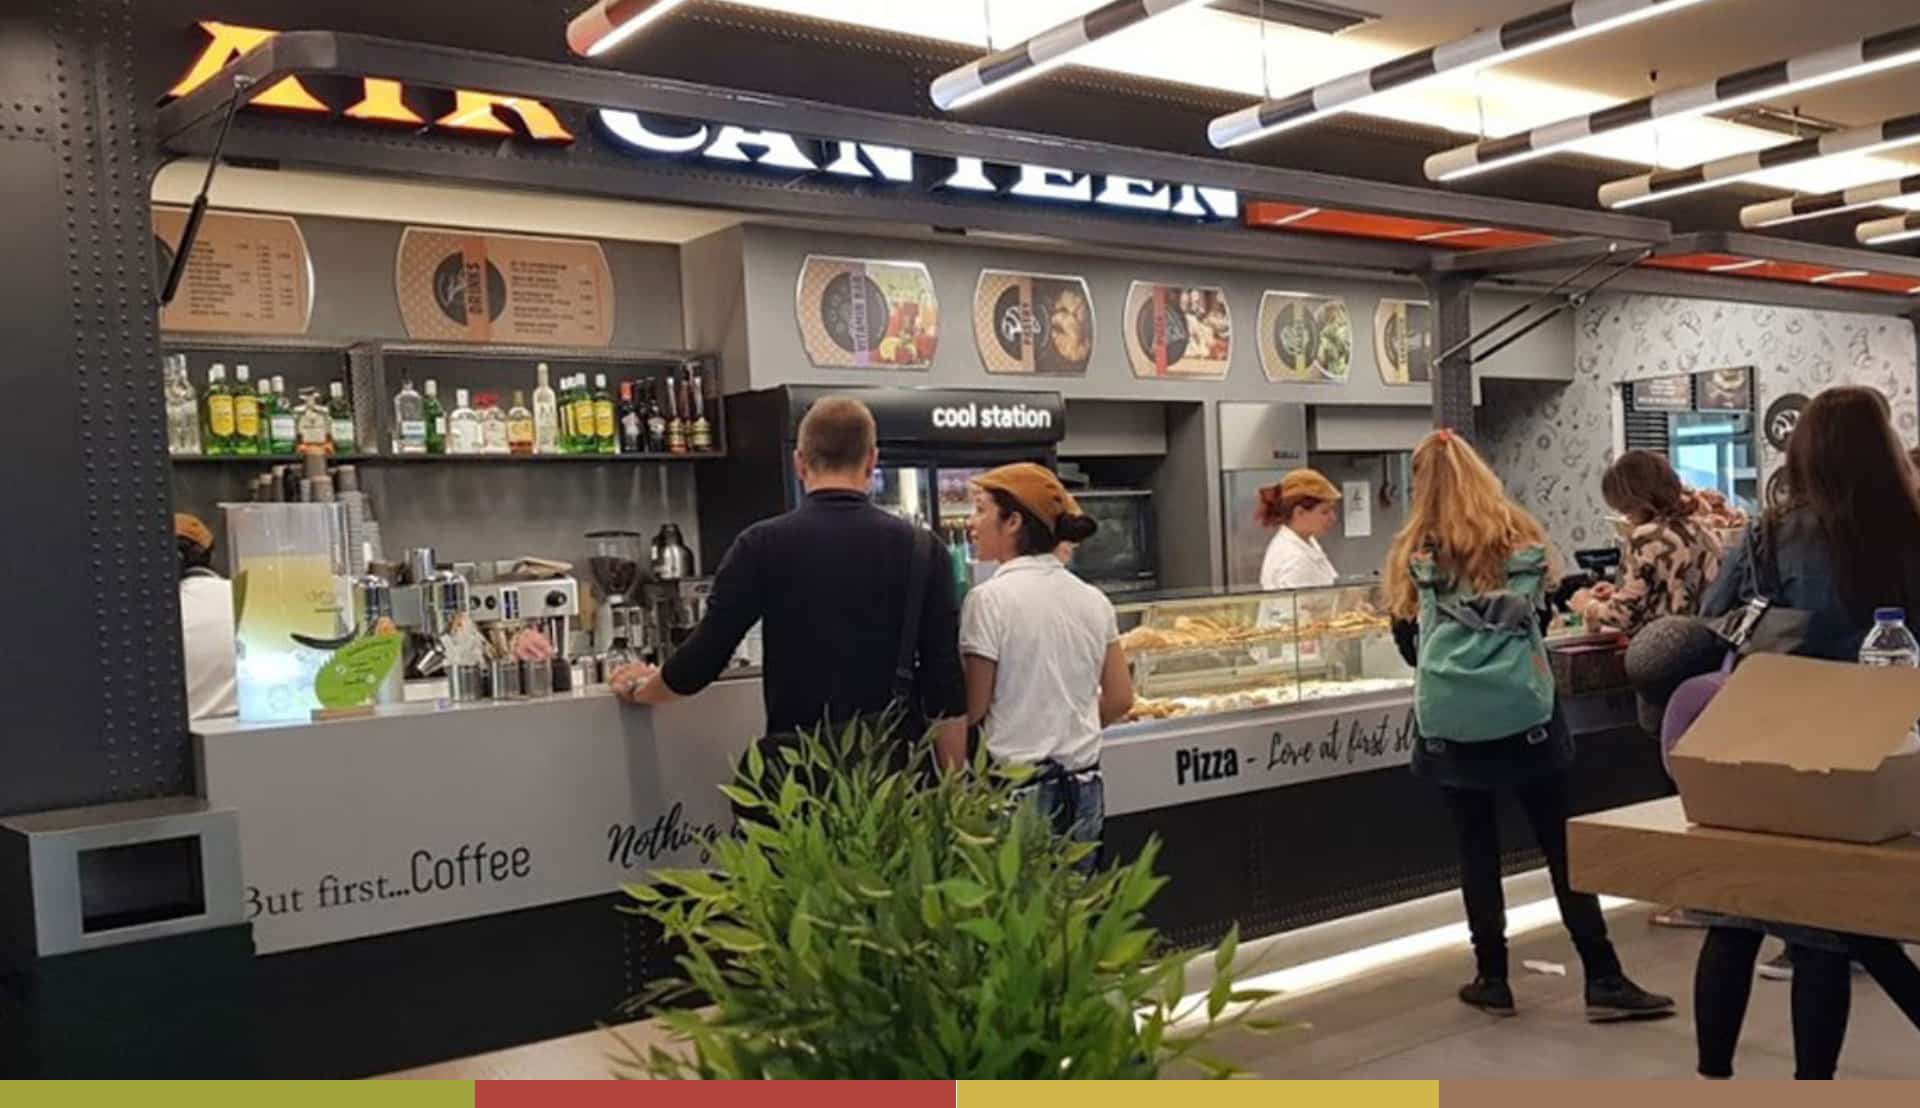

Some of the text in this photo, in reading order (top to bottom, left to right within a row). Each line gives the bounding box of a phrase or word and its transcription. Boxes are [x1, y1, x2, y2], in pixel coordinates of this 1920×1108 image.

[932, 402, 1052, 428] cool station
[1176, 747, 1239, 786] Pizza
[1266, 731, 1313, 771] Love
[1319, 719, 1339, 762] at
[1347, 713, 1390, 765] first
[1394, 706, 1416, 753] sl
[411, 841, 531, 894] Coffee
